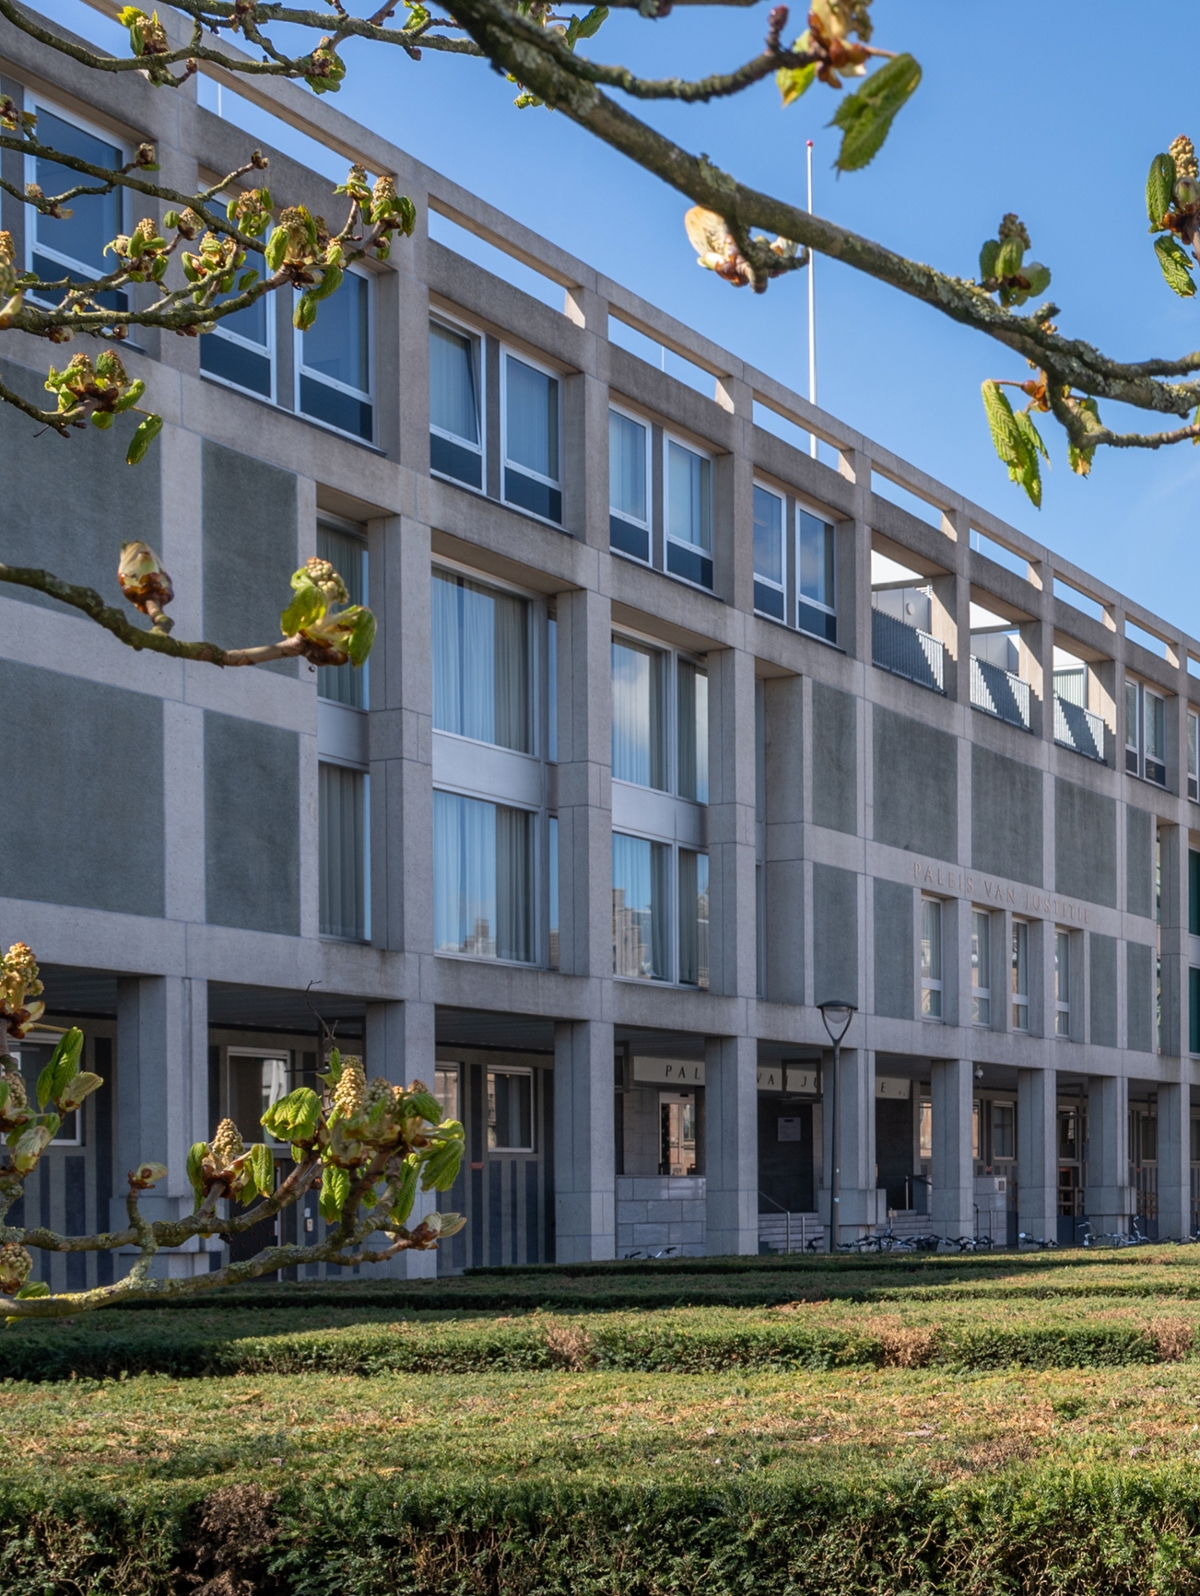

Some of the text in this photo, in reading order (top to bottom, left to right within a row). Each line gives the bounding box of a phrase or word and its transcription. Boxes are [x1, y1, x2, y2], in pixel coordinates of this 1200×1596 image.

[913, 861, 1090, 924] PALEIS VAN JUSTITIE
[665, 1064, 701, 1080] PAL
